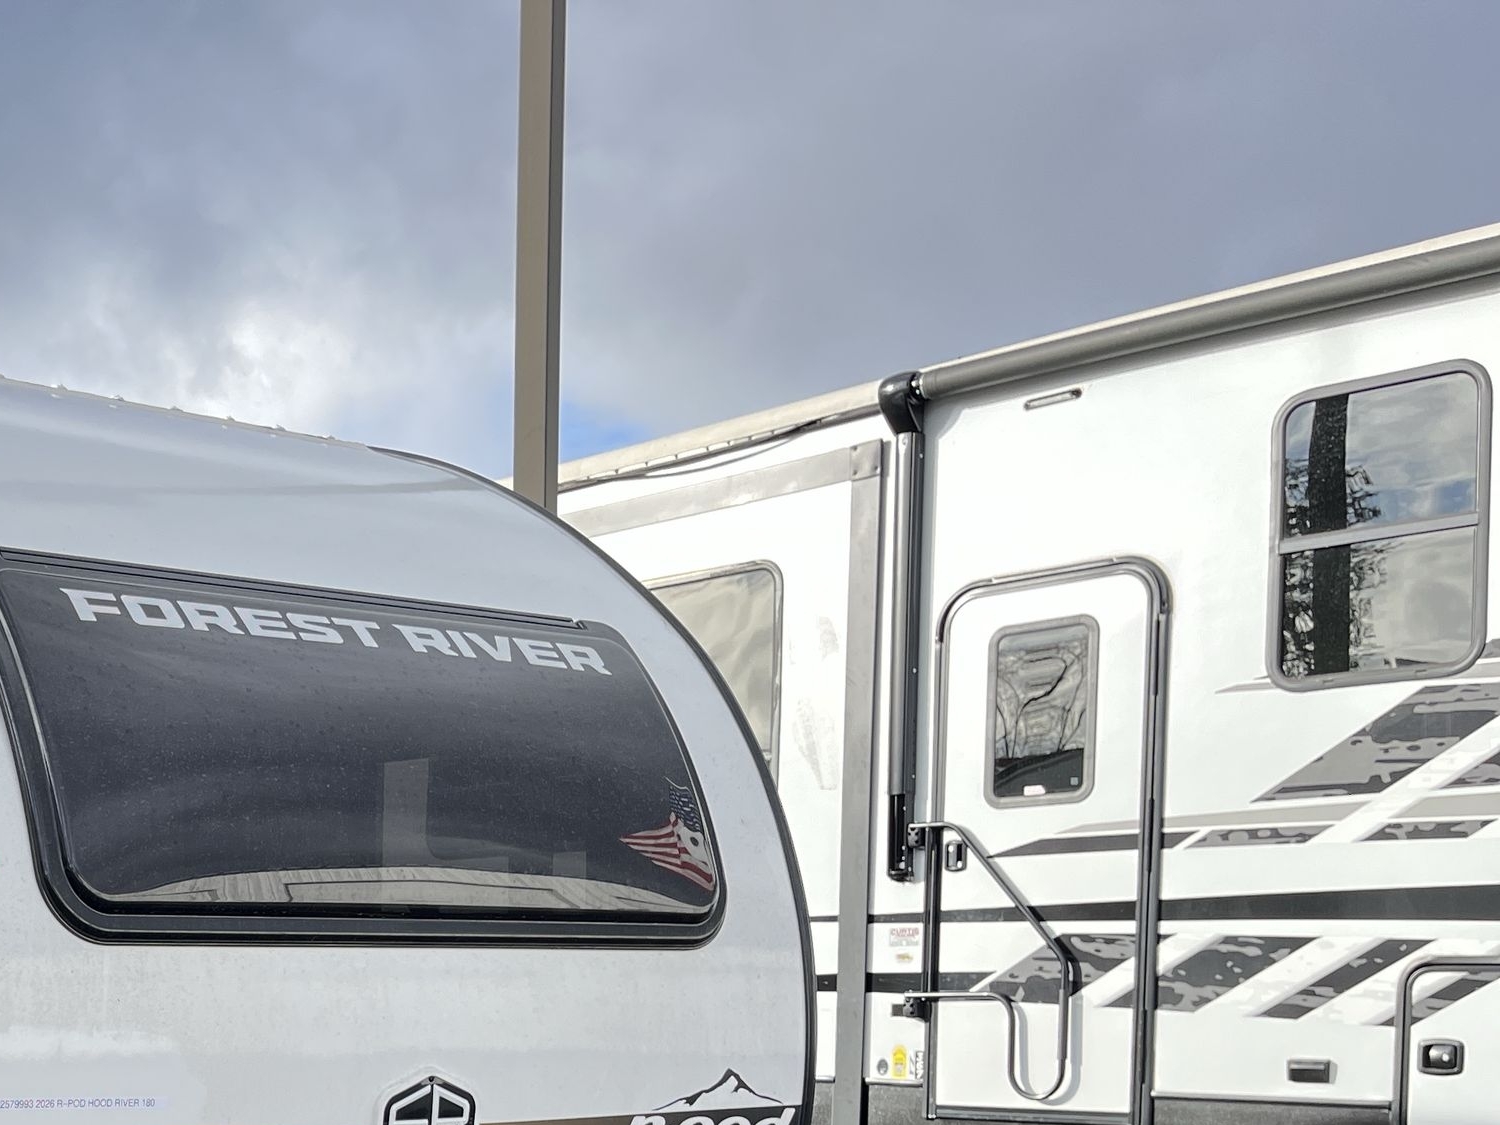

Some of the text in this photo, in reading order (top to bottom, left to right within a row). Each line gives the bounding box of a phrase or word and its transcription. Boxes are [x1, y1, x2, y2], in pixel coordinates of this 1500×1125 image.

[60, 588, 612, 675] FOREST RIVER
[0, 1098, 156, 1109] 2579993 2026 R-POD HOOD RIVER 180
